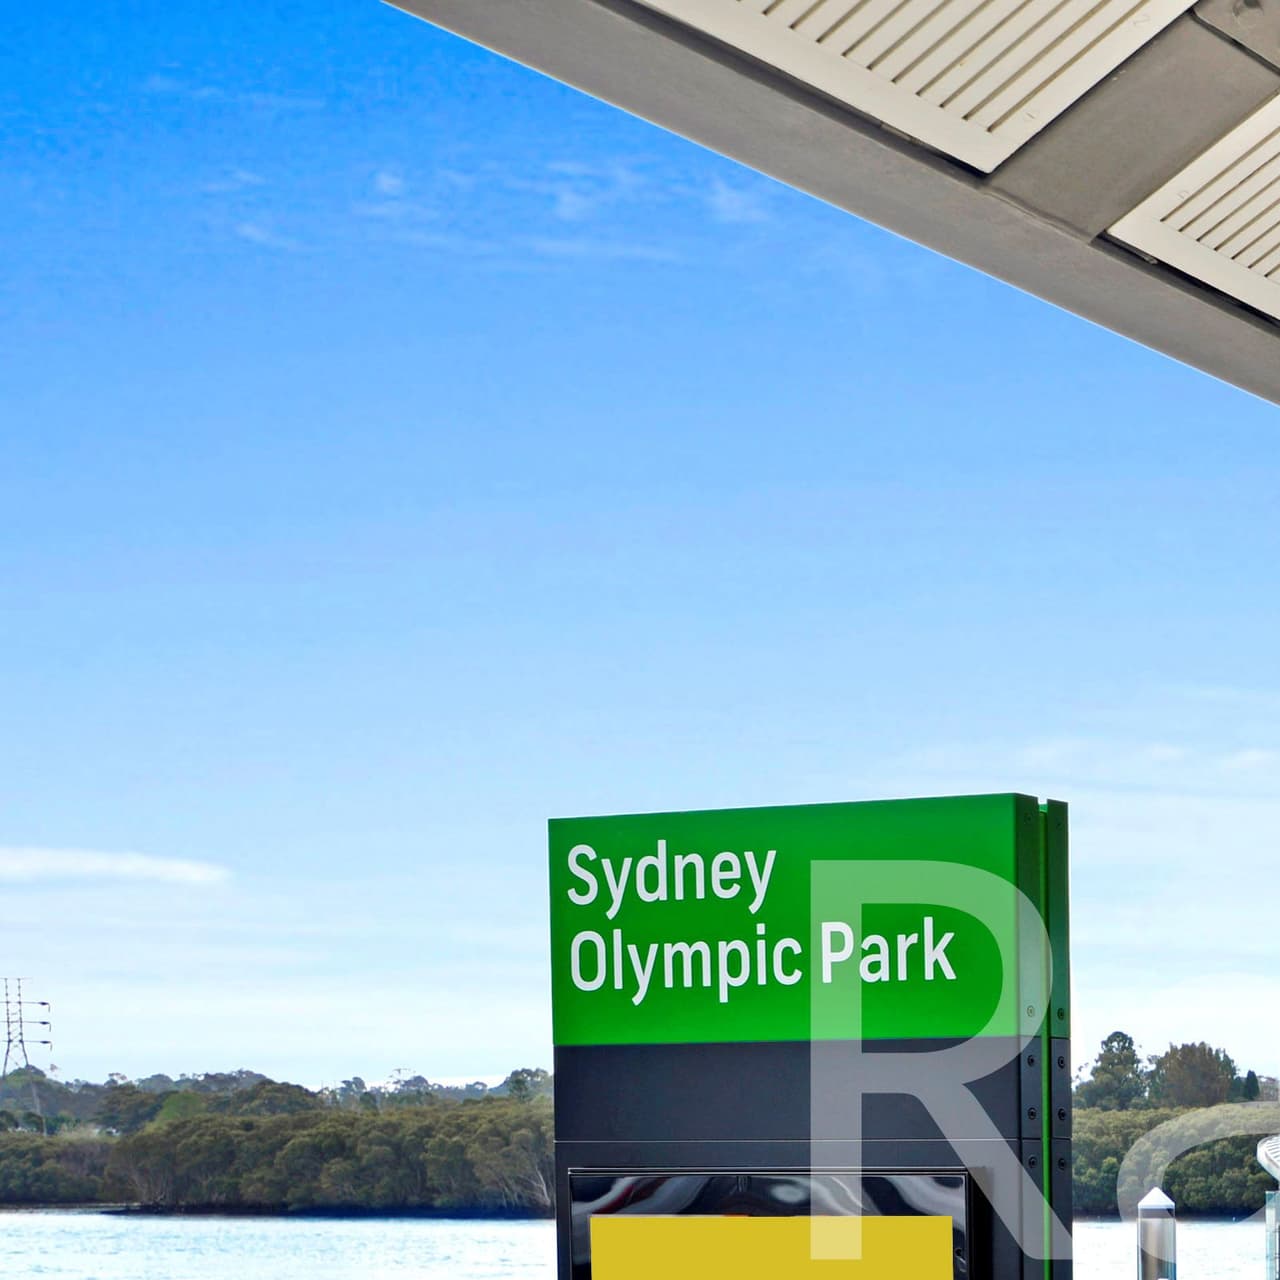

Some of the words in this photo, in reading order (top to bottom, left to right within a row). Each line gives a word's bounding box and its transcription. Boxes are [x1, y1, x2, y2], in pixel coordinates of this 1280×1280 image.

[567, 839, 776, 920] Sydney
[570, 923, 802, 1006] Olympic
[821, 916, 957, 984] Park
